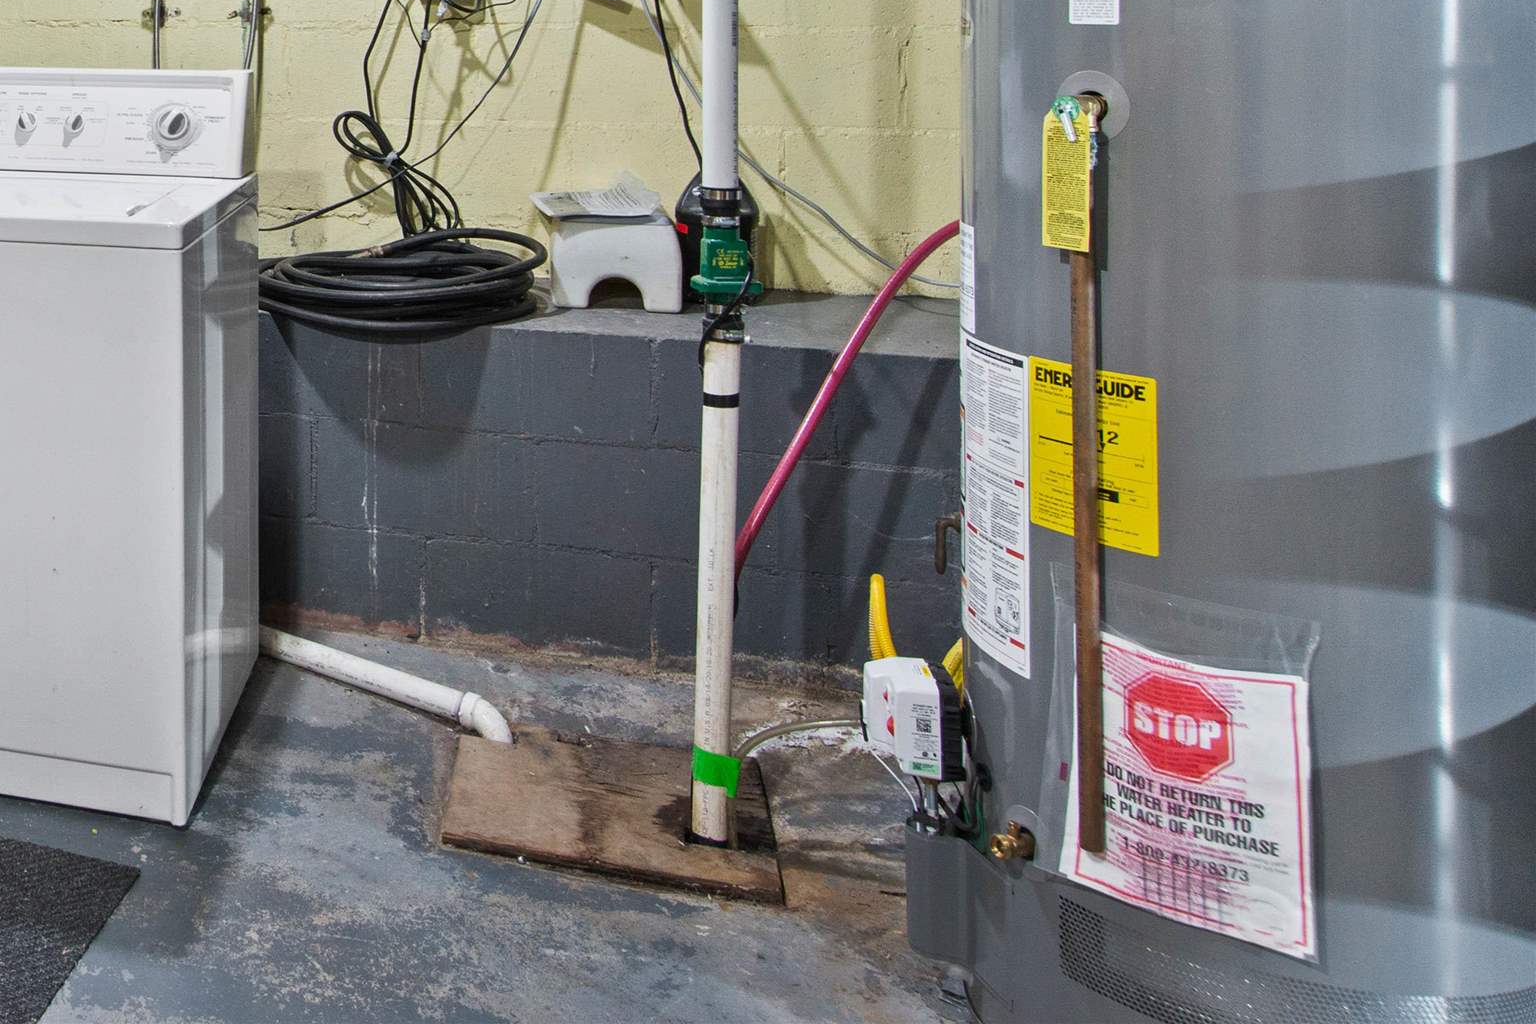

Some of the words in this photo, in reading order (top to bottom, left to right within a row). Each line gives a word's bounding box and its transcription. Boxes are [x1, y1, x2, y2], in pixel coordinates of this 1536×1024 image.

[1133, 701, 1222, 750] STOP
[1106, 761, 1123, 781] DO
[1127, 770, 1154, 792] NOT
[1160, 781, 1222, 811] RETURN
[1228, 798, 1265, 819] THIS
[1116, 782, 1162, 812] WATER
[1167, 801, 1225, 828] HEATER
[1232, 815, 1252, 834] TO
[1103, 794, 1117, 810] HE
[1120, 800, 1163, 829] PLACE
[1169, 818, 1189, 836] OF
[1193, 824, 1280, 857] PURCHASE
